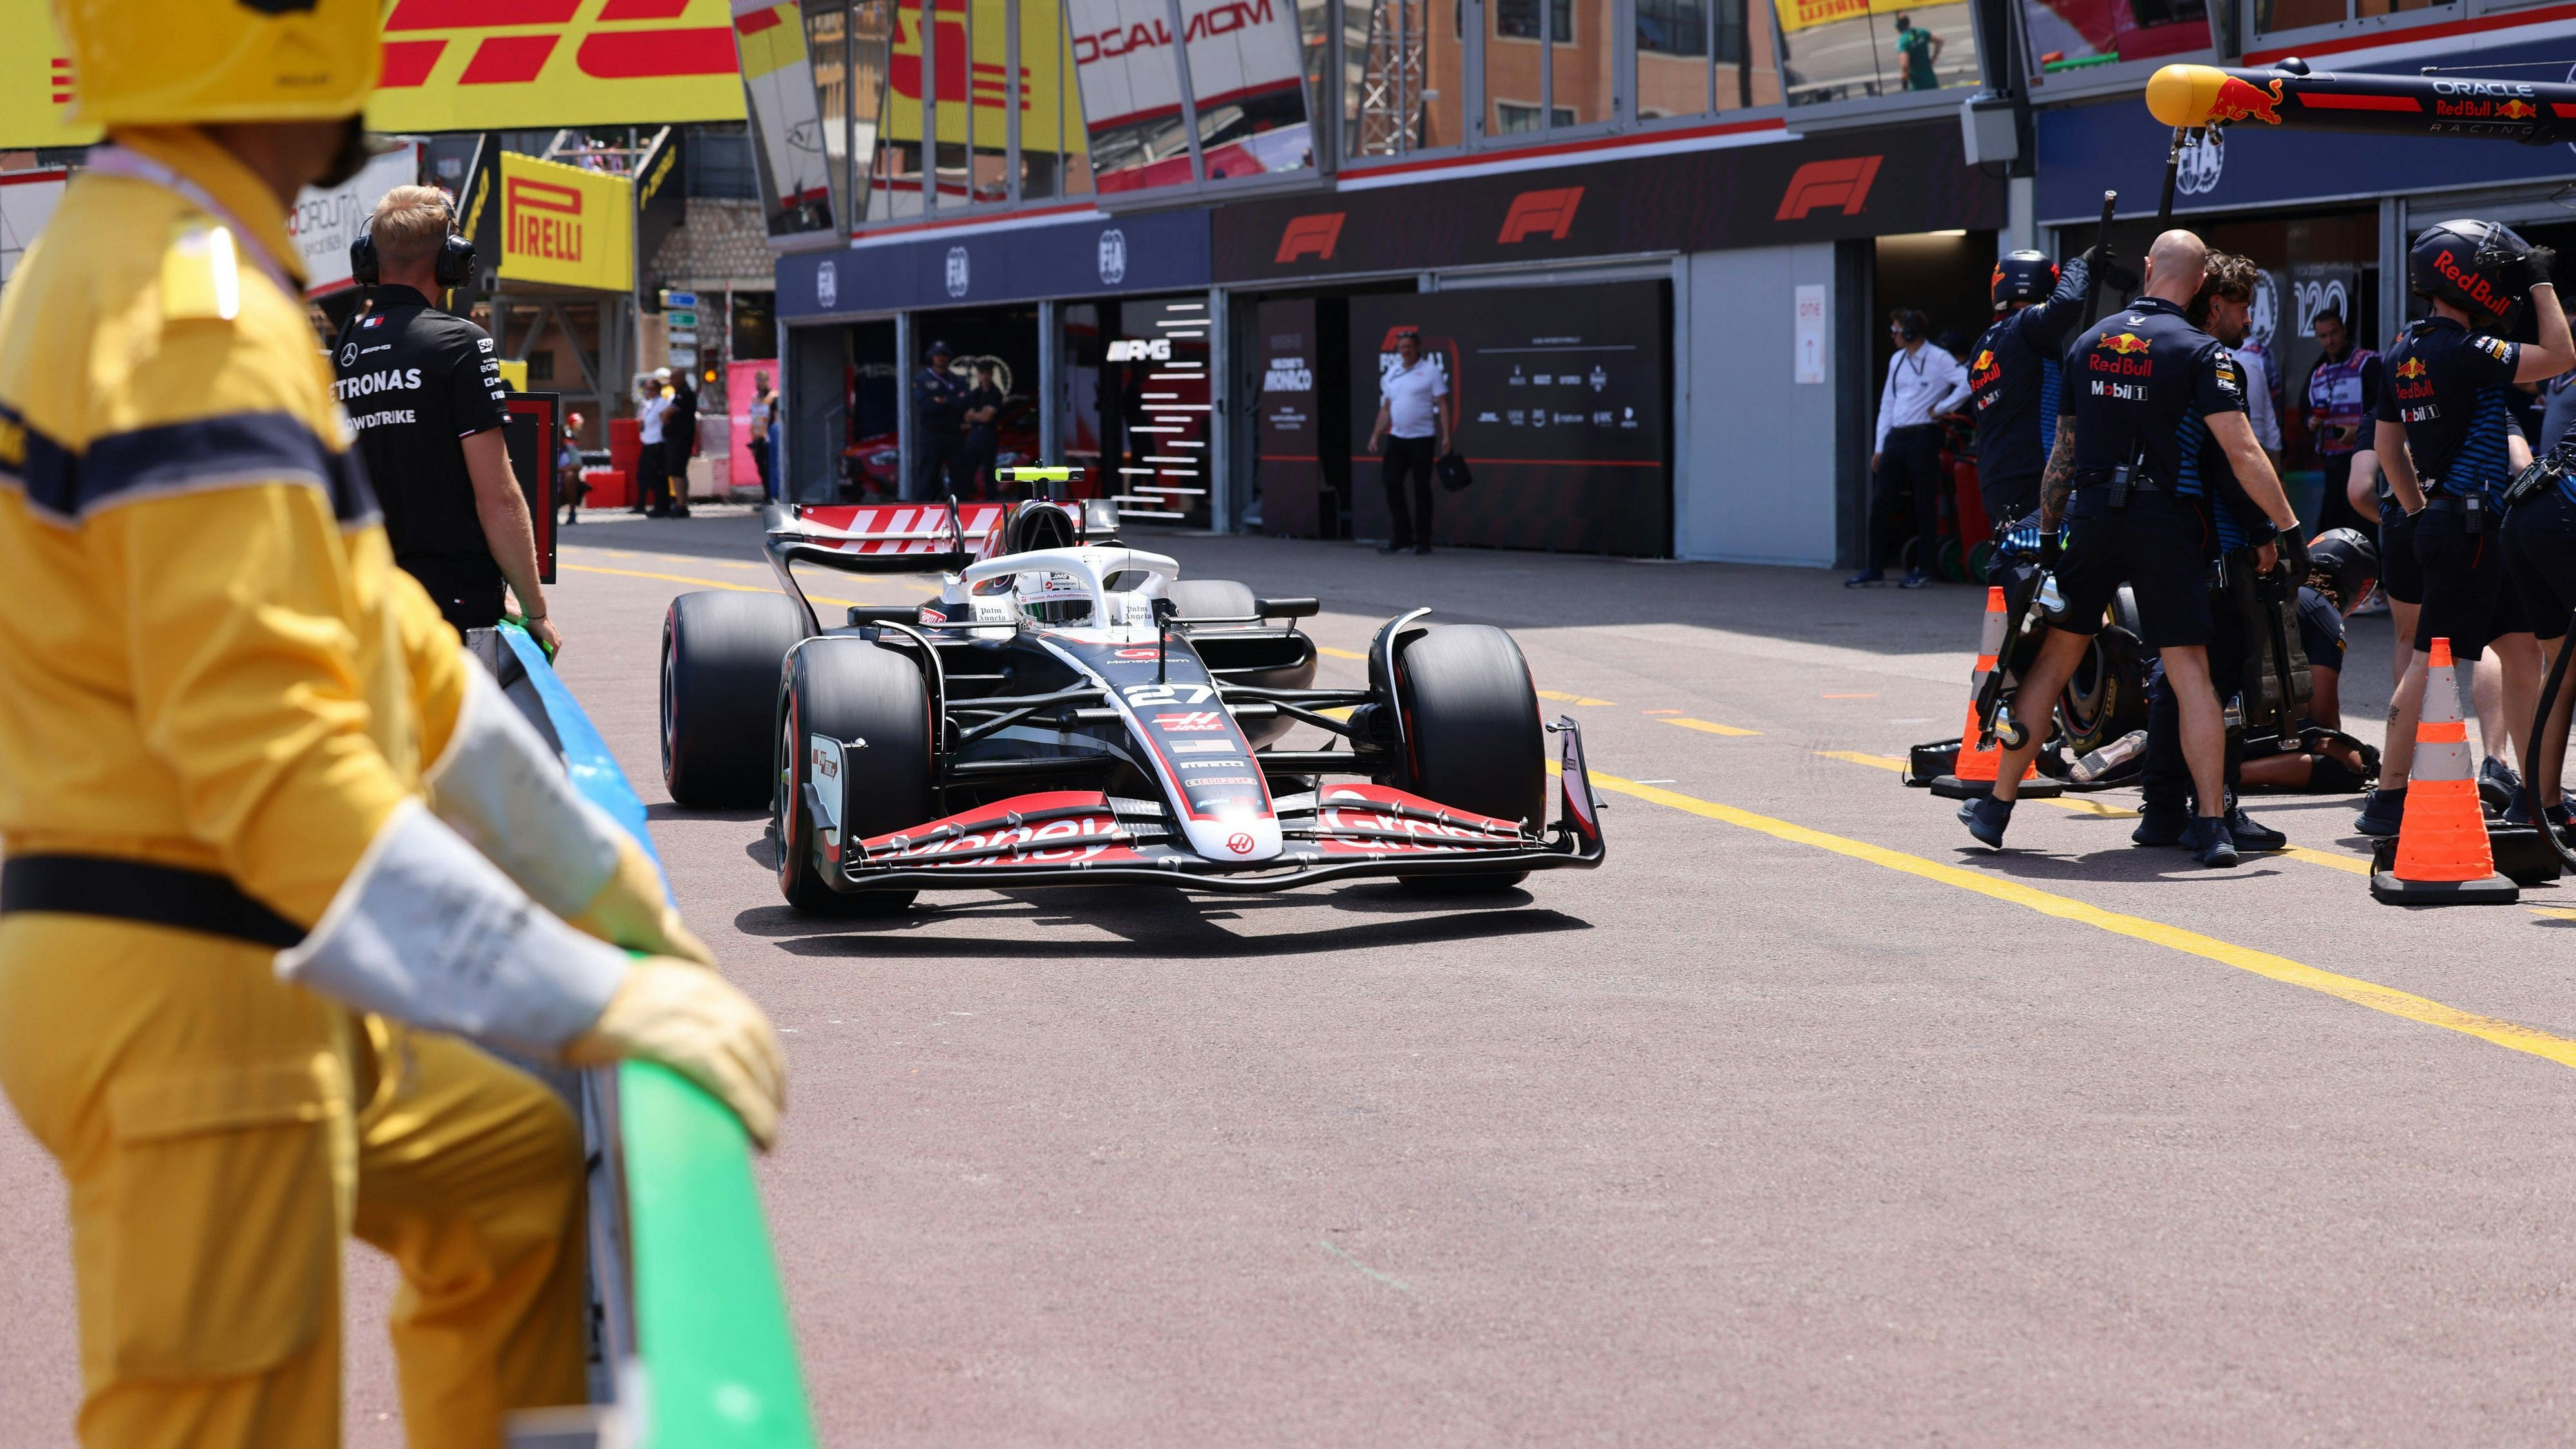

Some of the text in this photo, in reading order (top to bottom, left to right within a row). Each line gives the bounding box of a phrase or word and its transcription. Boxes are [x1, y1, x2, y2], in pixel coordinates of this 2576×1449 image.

[2433, 81, 2535, 97] ORACLE
[2437, 100, 2490, 117] Red Bull
[2430, 124, 2533, 135] RACING
[507, 176, 582, 262] PIRELLI
[2434, 250, 2512, 317] Red Bull
[478, 340, 493, 352] SAP
[2088, 354, 2153, 377] Red Bull
[329, 368, 422, 402] ETRONAS
[2092, 381, 2132, 399] Mobil
[2415, 379, 2435, 396] Bull
[346, 410, 416, 431] OWDTRIKE
[1122, 684, 1215, 708] 27
[1180, 761, 1245, 769] PIRELLI
[1325, 790, 1511, 851] Gram
[883, 817, 1119, 867] Money
